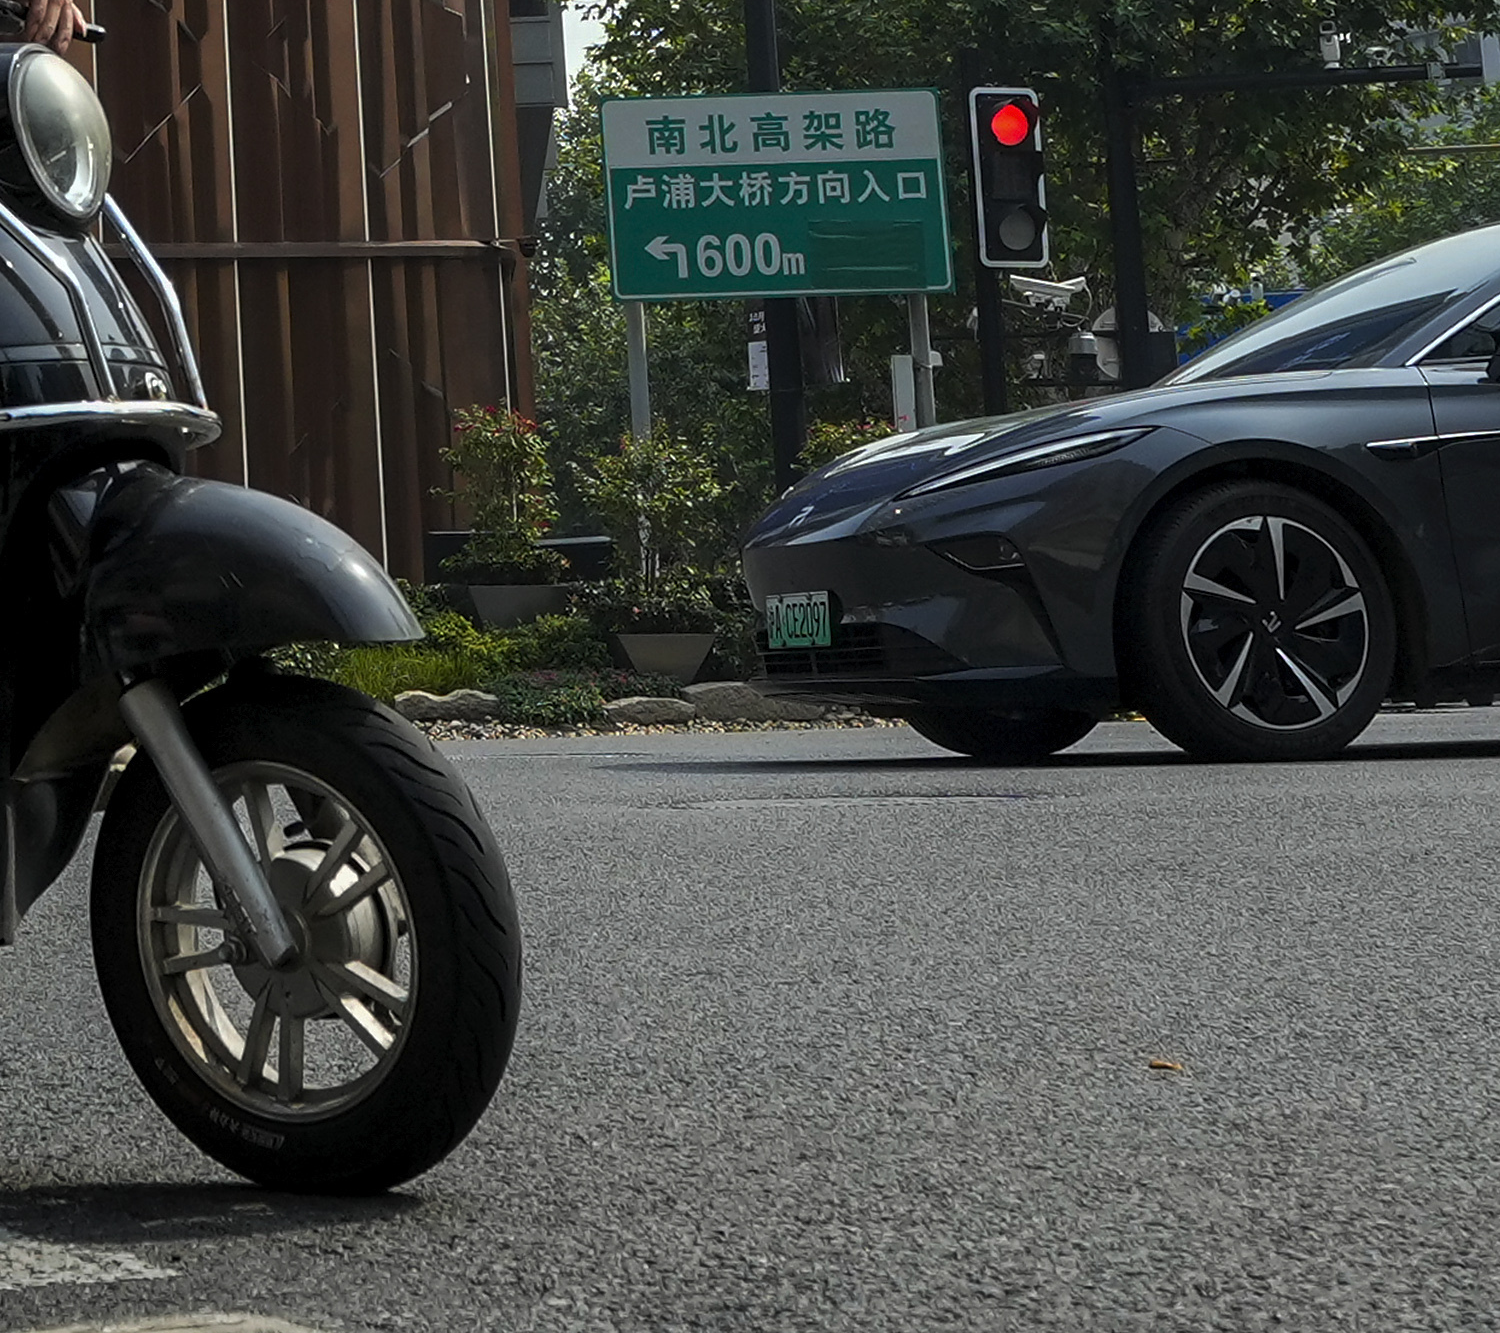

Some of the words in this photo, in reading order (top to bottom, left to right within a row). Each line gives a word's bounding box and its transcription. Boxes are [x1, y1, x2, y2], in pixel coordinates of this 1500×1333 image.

[645, 108, 898, 156] 南北高架路
[623, 167, 928, 210] 卢浦大桥方向入口
[694, 232, 806, 278] 600m
